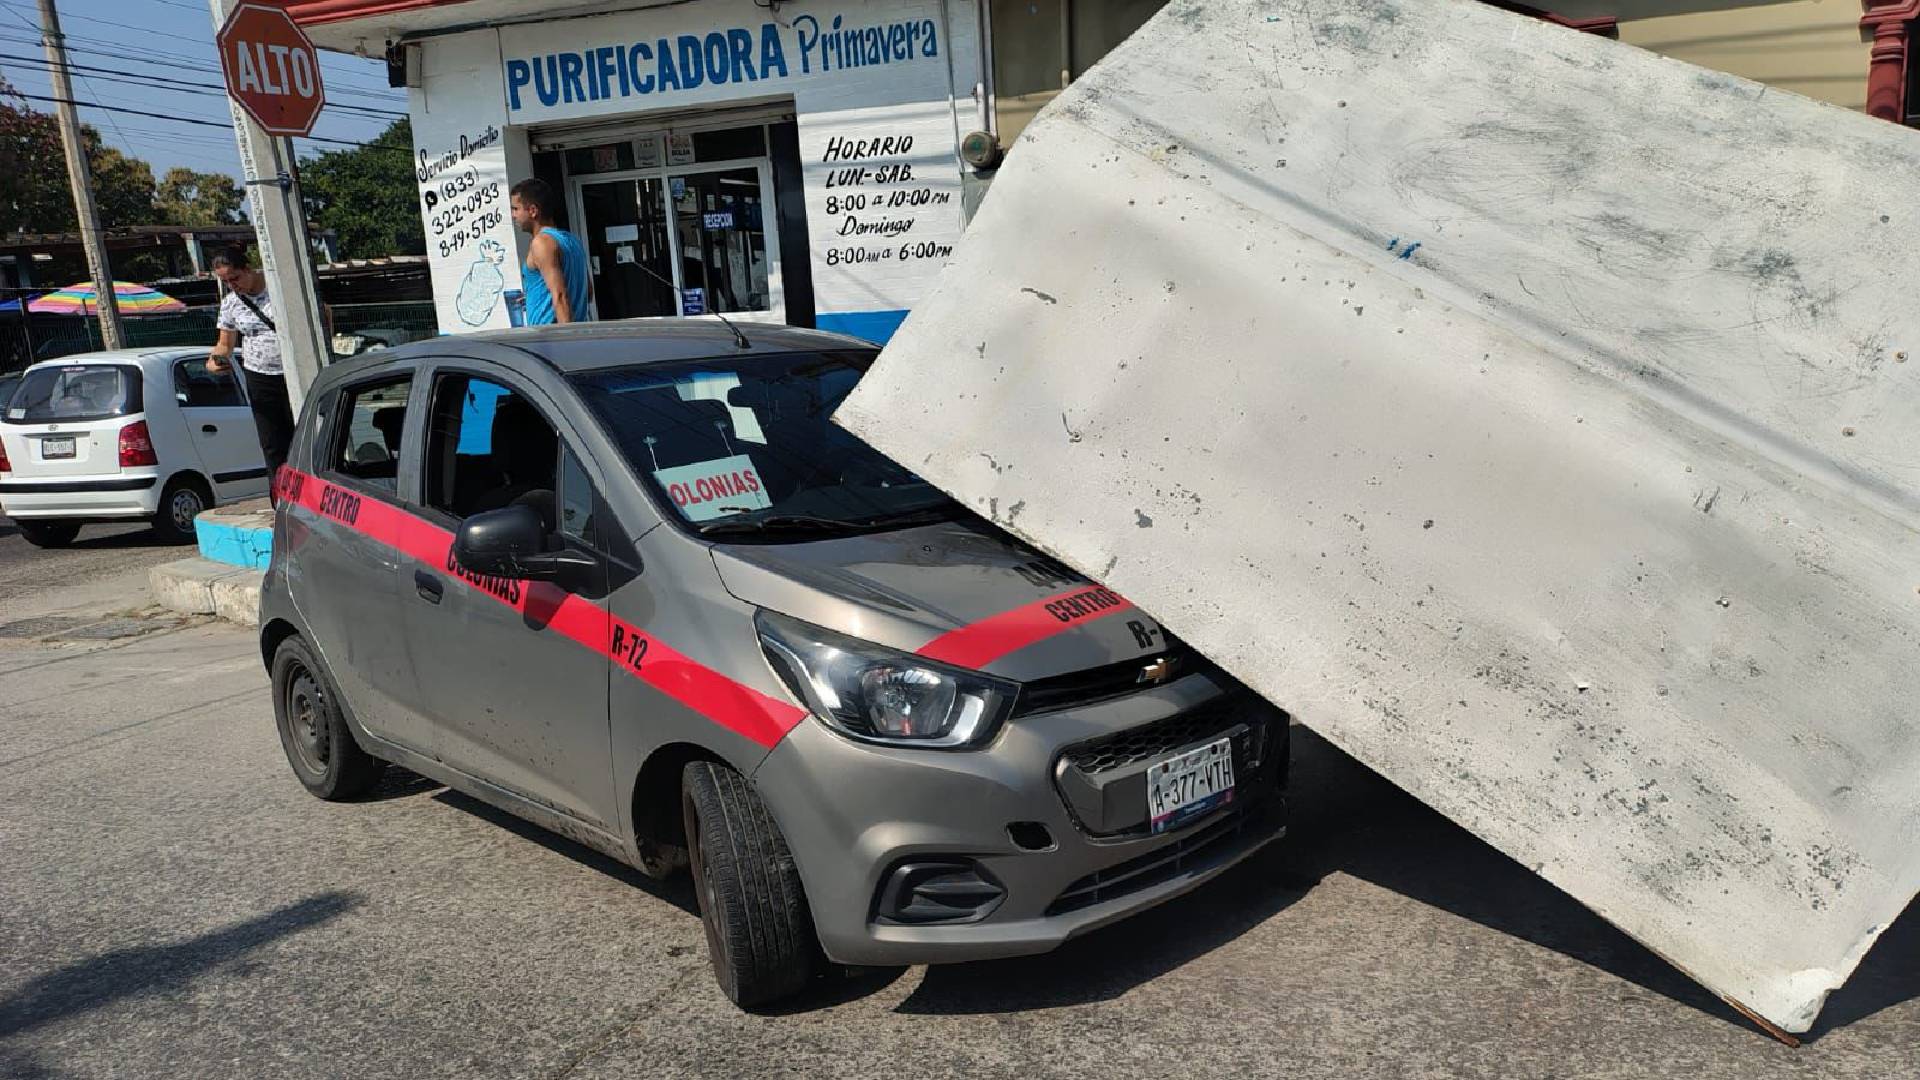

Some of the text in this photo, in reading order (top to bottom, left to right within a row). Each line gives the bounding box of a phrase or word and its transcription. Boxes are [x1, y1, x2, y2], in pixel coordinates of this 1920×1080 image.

[237, 40, 314, 97] ALTO
[506, 14, 938, 111] PURIFICADORA Primavera
[823, 135, 914, 162] HORARIO
[440, 164, 480, 202] (833)
[826, 195, 867, 214] 8:00
[871, 195, 884, 206] a
[836, 215, 915, 237] Domingo
[320, 484, 361, 526] CENTRO
[669, 469, 760, 507] OLONIAS
[612, 624, 649, 671] R-72
[1154, 757, 1232, 814] A-377-VTH
